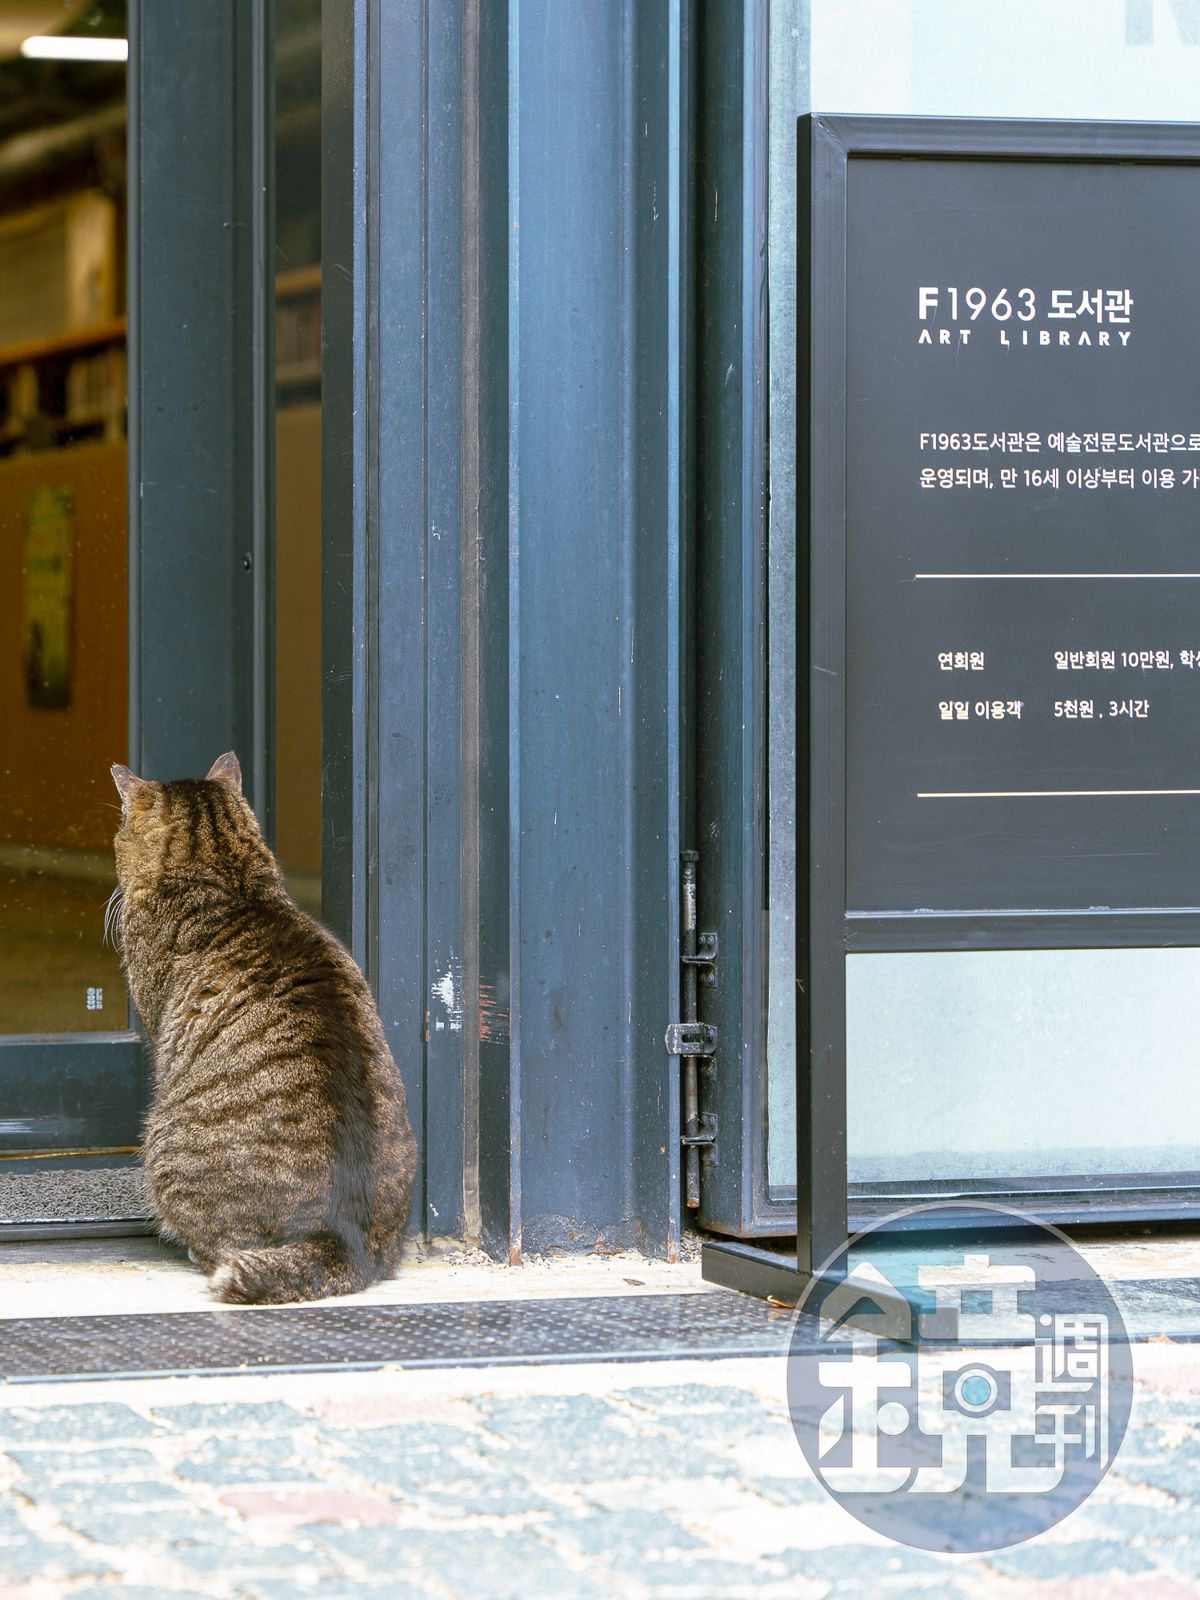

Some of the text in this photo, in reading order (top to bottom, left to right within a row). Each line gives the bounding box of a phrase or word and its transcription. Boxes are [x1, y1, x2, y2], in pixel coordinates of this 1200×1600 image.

[918, 286, 1134, 324] F1963 도서관
[918, 329, 1132, 346] ART LIBRARY
[919, 431, 1200, 453] F1963도서관은 예술전문도서관으로
[919, 467, 994, 490] 운영되며,
[1000, 467, 1018, 488] 만
[1023, 467, 1060, 489] 16세
[1065, 466, 1135, 489] 이상부터
[1141, 467, 1176, 489] 이용
[937, 651, 985, 671] 연회원
[1053, 650, 1116, 670] 일반회원
[1120, 650, 1174, 670] 10만원,
[938, 700, 1023, 720] 일일 이용객
[1053, 699, 1094, 719] 5천원
[1108, 699, 1150, 719] 3시간
